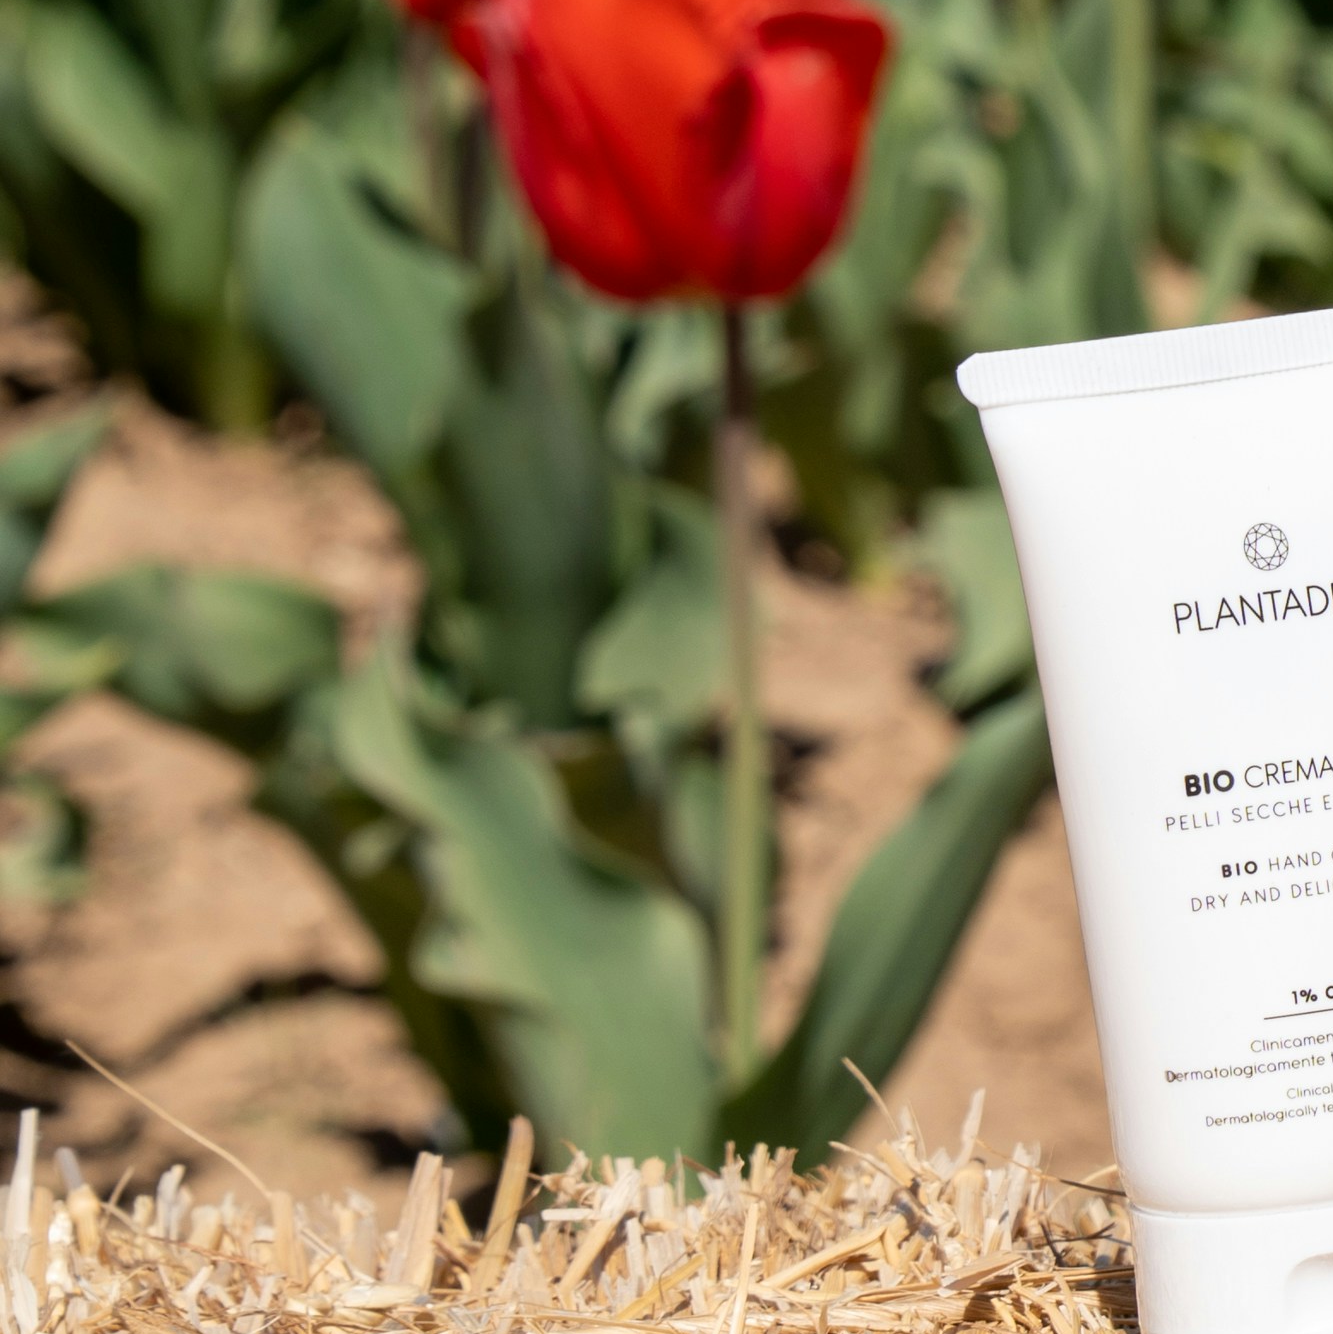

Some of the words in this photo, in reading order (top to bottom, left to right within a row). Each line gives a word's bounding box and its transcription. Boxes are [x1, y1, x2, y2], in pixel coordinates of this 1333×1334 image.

[1184, 770, 1234, 797] BIO
[1166, 811, 1220, 832] PELLI
[1232, 797, 1312, 823] SECCHE
[1323, 794, 1332, 810] E
[1221, 861, 1258, 878] BIO
[1269, 851, 1321, 871] HAND
[1191, 894, 1228, 912] DRY
[1240, 887, 1280, 905] AND
[1292, 989, 1318, 1004] 1%
[1165, 1055, 1325, 1083] Dermatologicamente
[1206, 1105, 1318, 1127] Dermatologically
